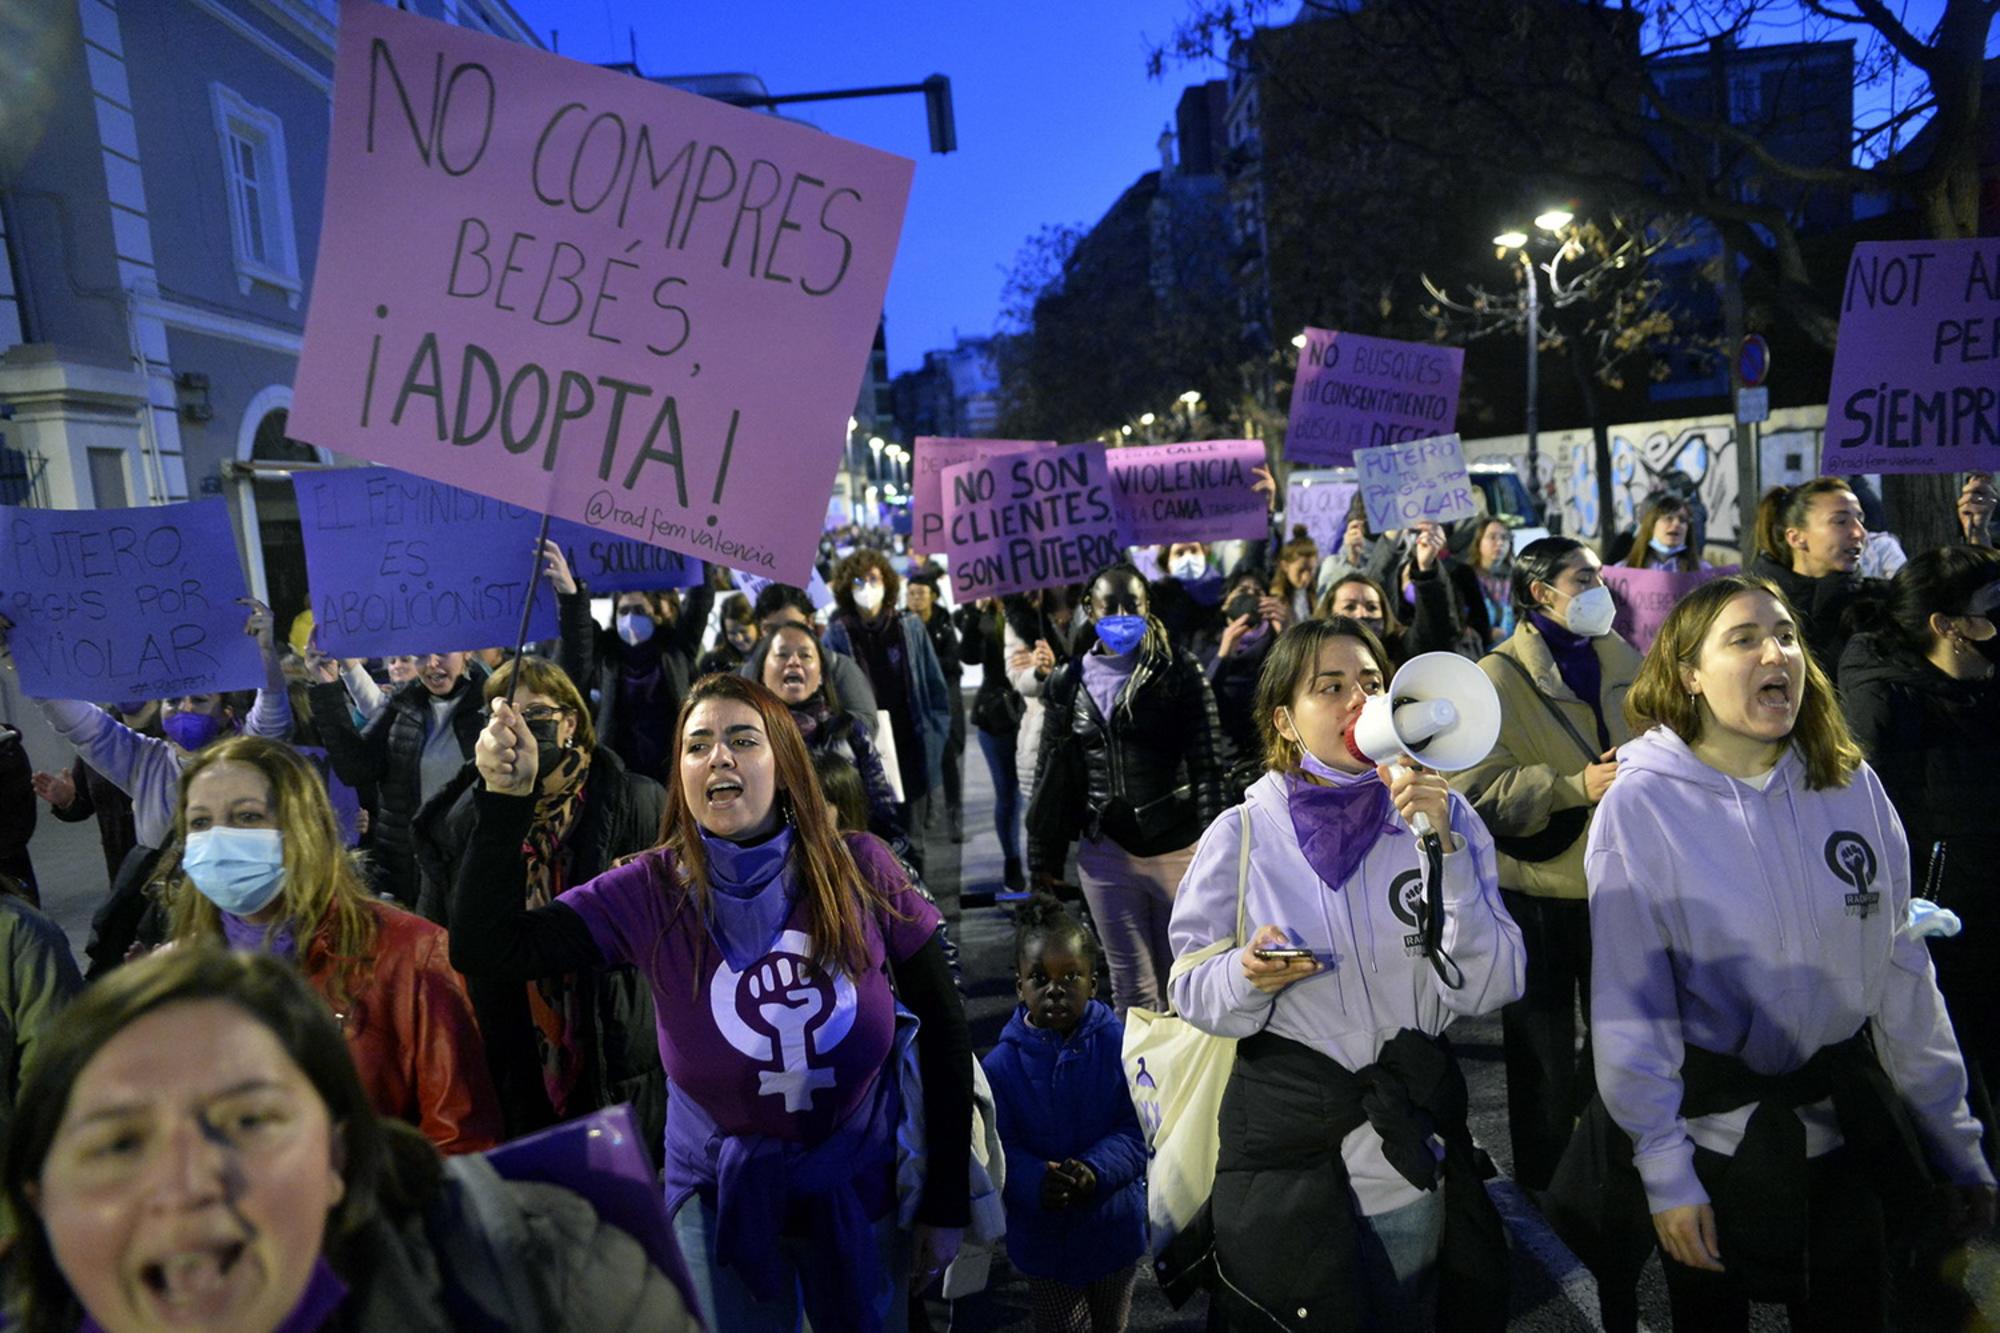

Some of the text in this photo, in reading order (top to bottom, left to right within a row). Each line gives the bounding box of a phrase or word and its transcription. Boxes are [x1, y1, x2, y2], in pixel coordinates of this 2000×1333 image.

[366, 37, 863, 297] NO COMPRES
[446, 216, 703, 377] BEBÉS,
[1845, 253, 1936, 313] NOT
[1308, 340, 1445, 385] NO BUSQUES
[1933, 317, 2000, 365] PE
[360, 303, 741, 528] ¡ADOPTA!
[953, 453, 1090, 506] NO SON
[1363, 441, 1456, 479] PUTERO
[313, 484, 355, 531] EL
[1152, 497, 1204, 521] CAMA
[1368, 488, 1473, 526] VIOLAR
[380, 540, 430, 577] ES
[956, 555, 1006, 592] SON
[135, 579, 210, 616] POR
